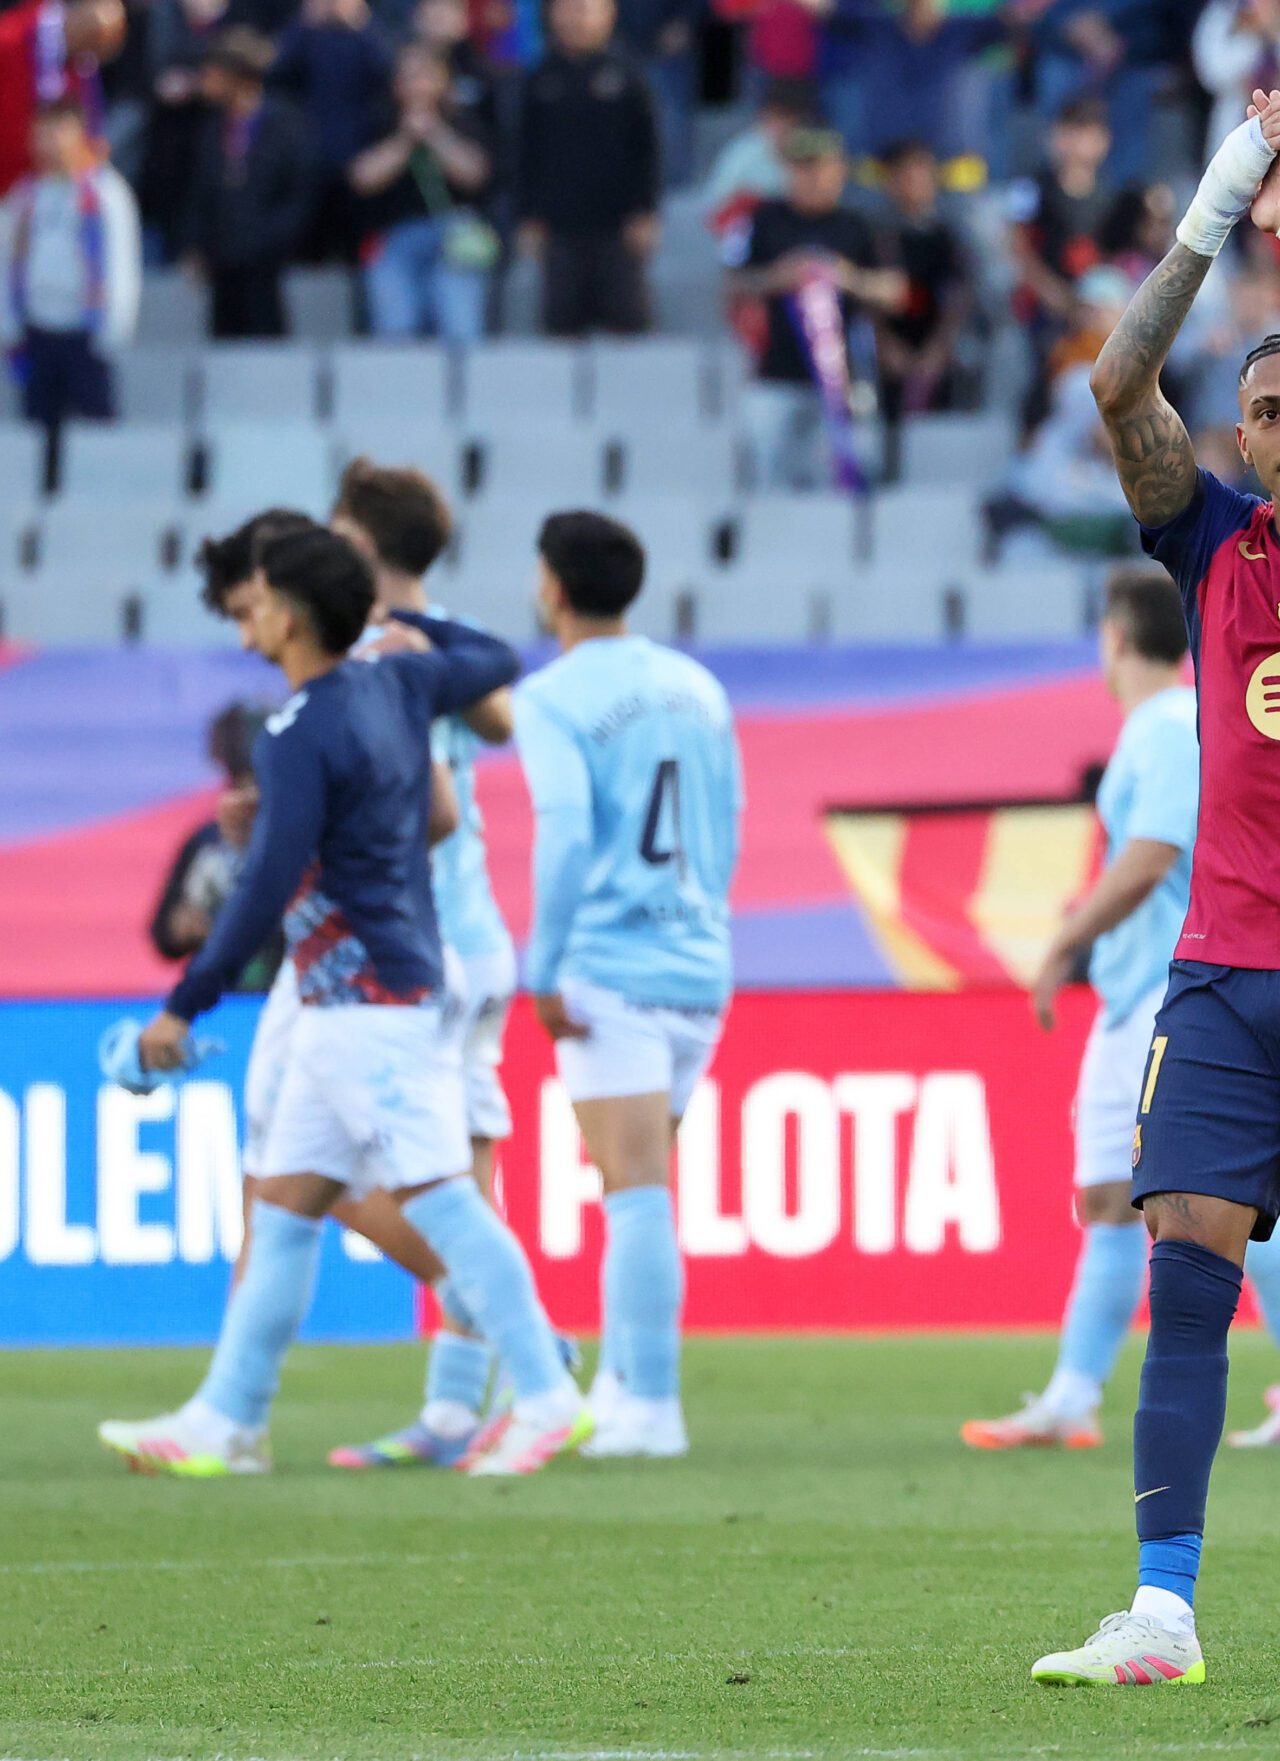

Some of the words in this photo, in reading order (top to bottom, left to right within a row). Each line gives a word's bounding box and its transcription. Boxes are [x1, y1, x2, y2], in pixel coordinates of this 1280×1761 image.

[640, 760, 688, 886] 4
[0, 1081, 245, 1266] LEM
[538, 1069, 1001, 1260] PLOTA
